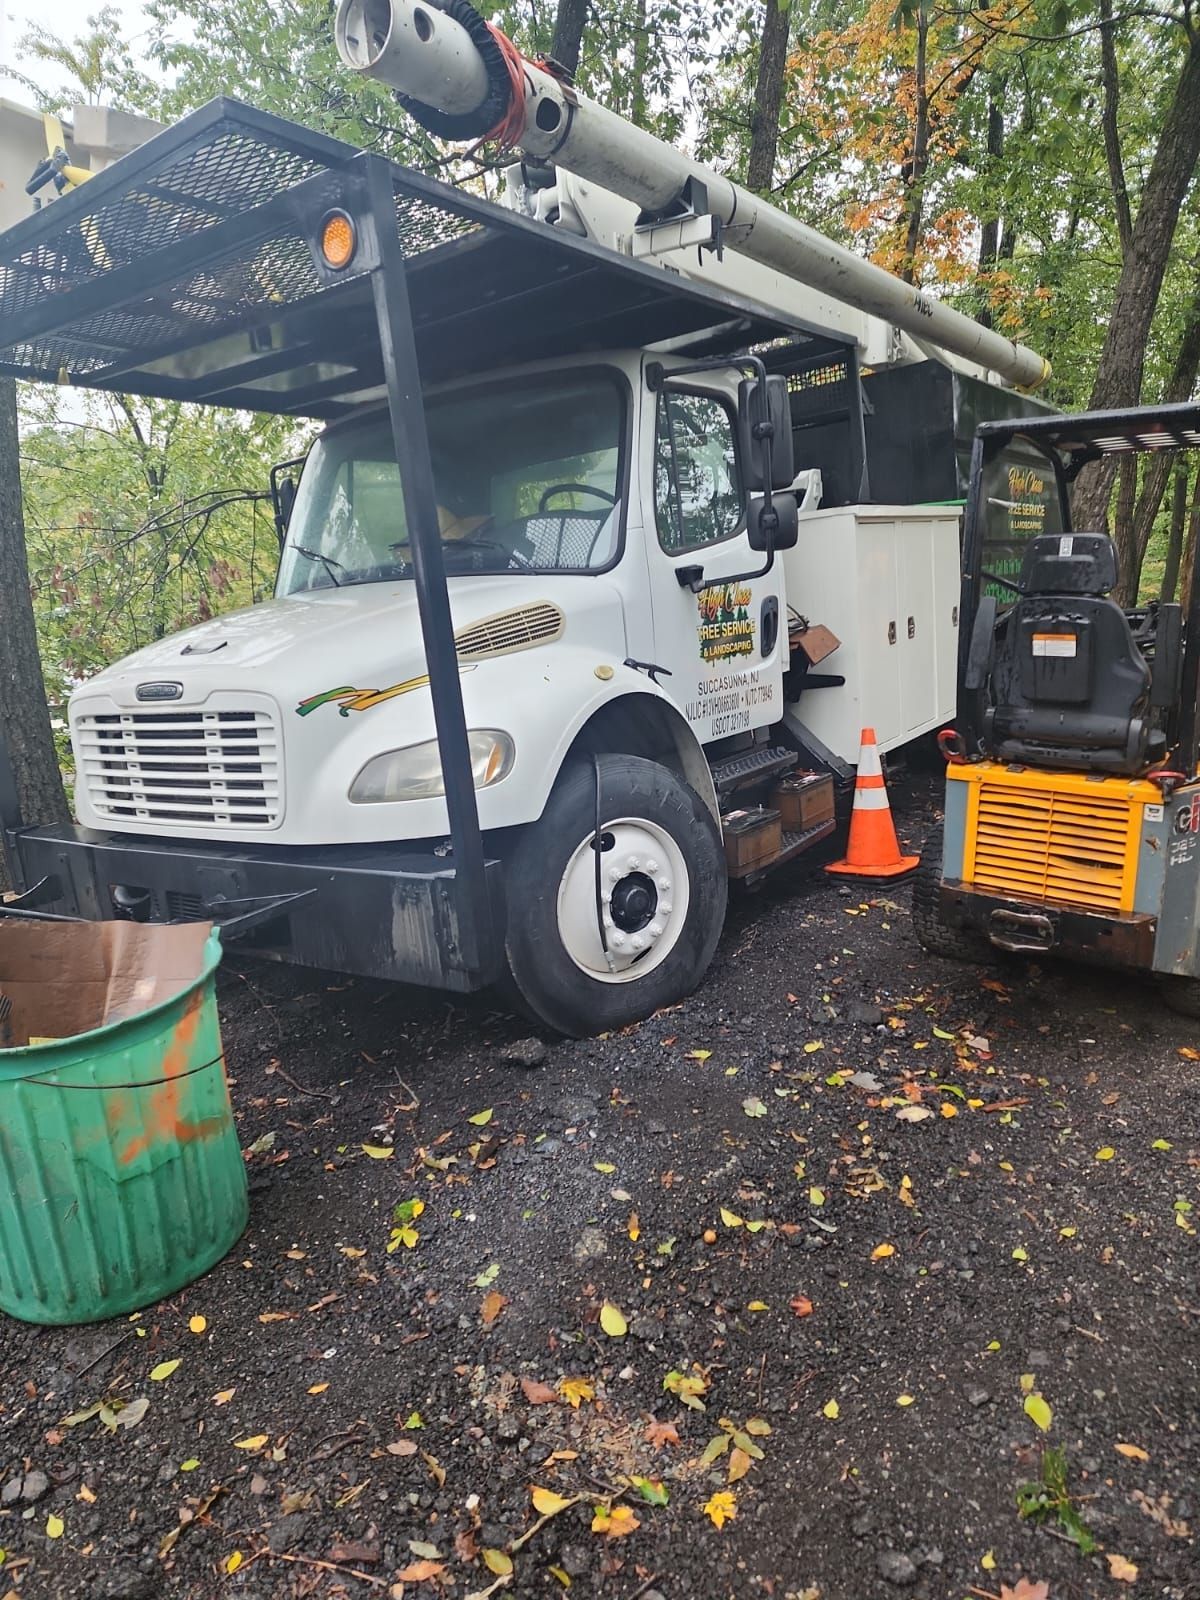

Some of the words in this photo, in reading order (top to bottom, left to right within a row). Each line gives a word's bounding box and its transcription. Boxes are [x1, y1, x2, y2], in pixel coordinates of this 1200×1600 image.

[1008, 467, 1025, 498] High
[1022, 503, 1046, 517] SERVICE
[1014, 520, 1042, 530] LANDSCAPING
[698, 584, 724, 621] High
[724, 582, 752, 613] Class
[697, 624, 721, 641] TREE
[722, 618, 756, 637] SERVICE
[704, 647, 709, 657] &
[709, 640, 751, 656] LANDSCAPING
[698, 672, 750, 696] SUCCASUNNA,
[751, 670, 760, 684] NJ
[711, 714, 730, 736] USDOT
